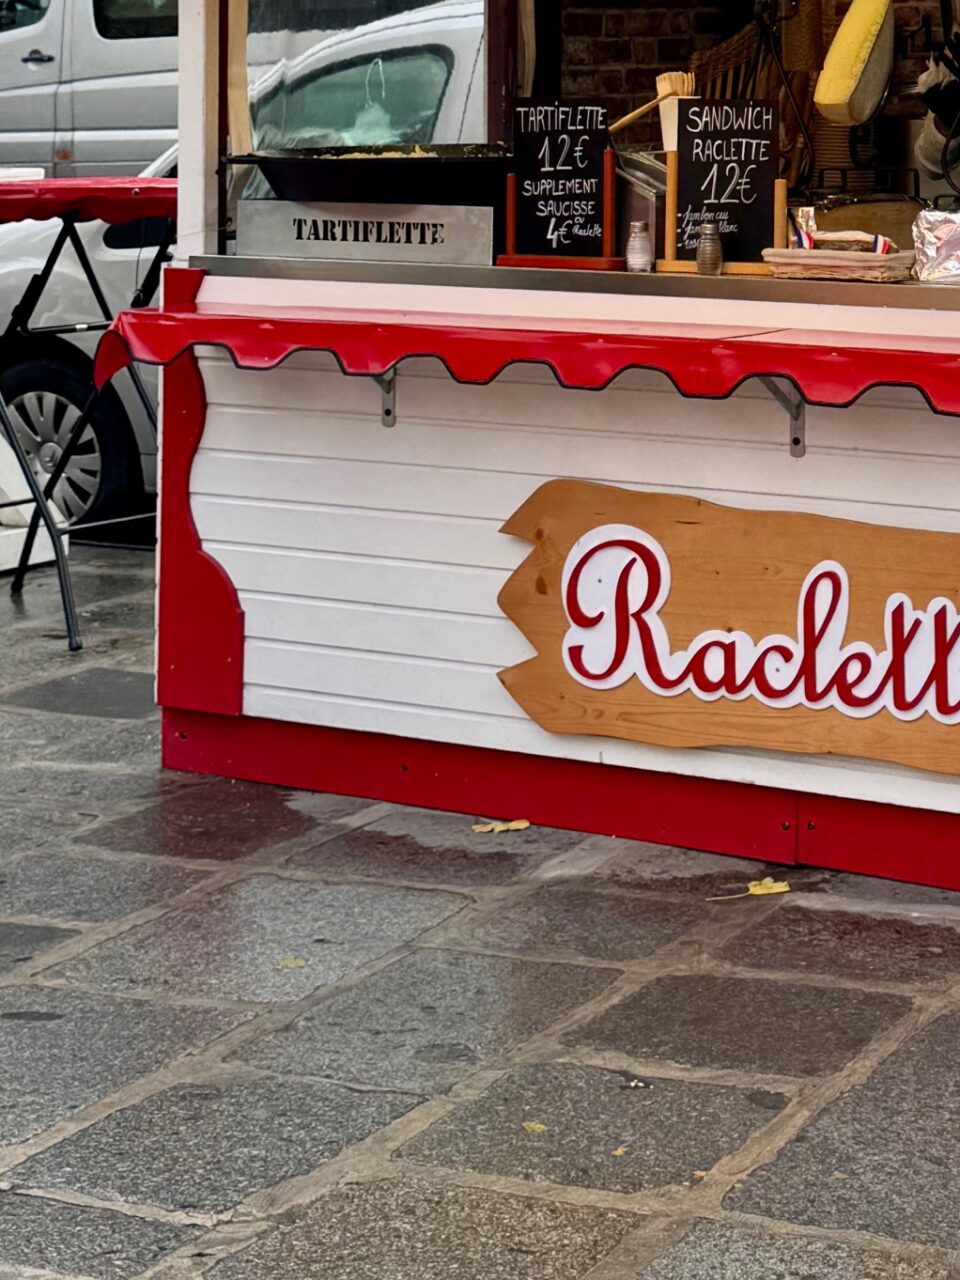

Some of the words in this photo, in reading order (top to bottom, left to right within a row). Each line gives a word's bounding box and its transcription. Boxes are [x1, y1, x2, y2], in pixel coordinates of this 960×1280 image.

[538, 134, 590, 172] 12€
[692, 138, 771, 162] RACLETTE
[522, 178, 599, 197] SUPPLEMENT
[701, 162, 758, 204] 12€
[536, 200, 596, 217] SAUCISSE
[292, 218, 445, 246] TARTIFLETTE
[546, 217, 573, 249] 4€
